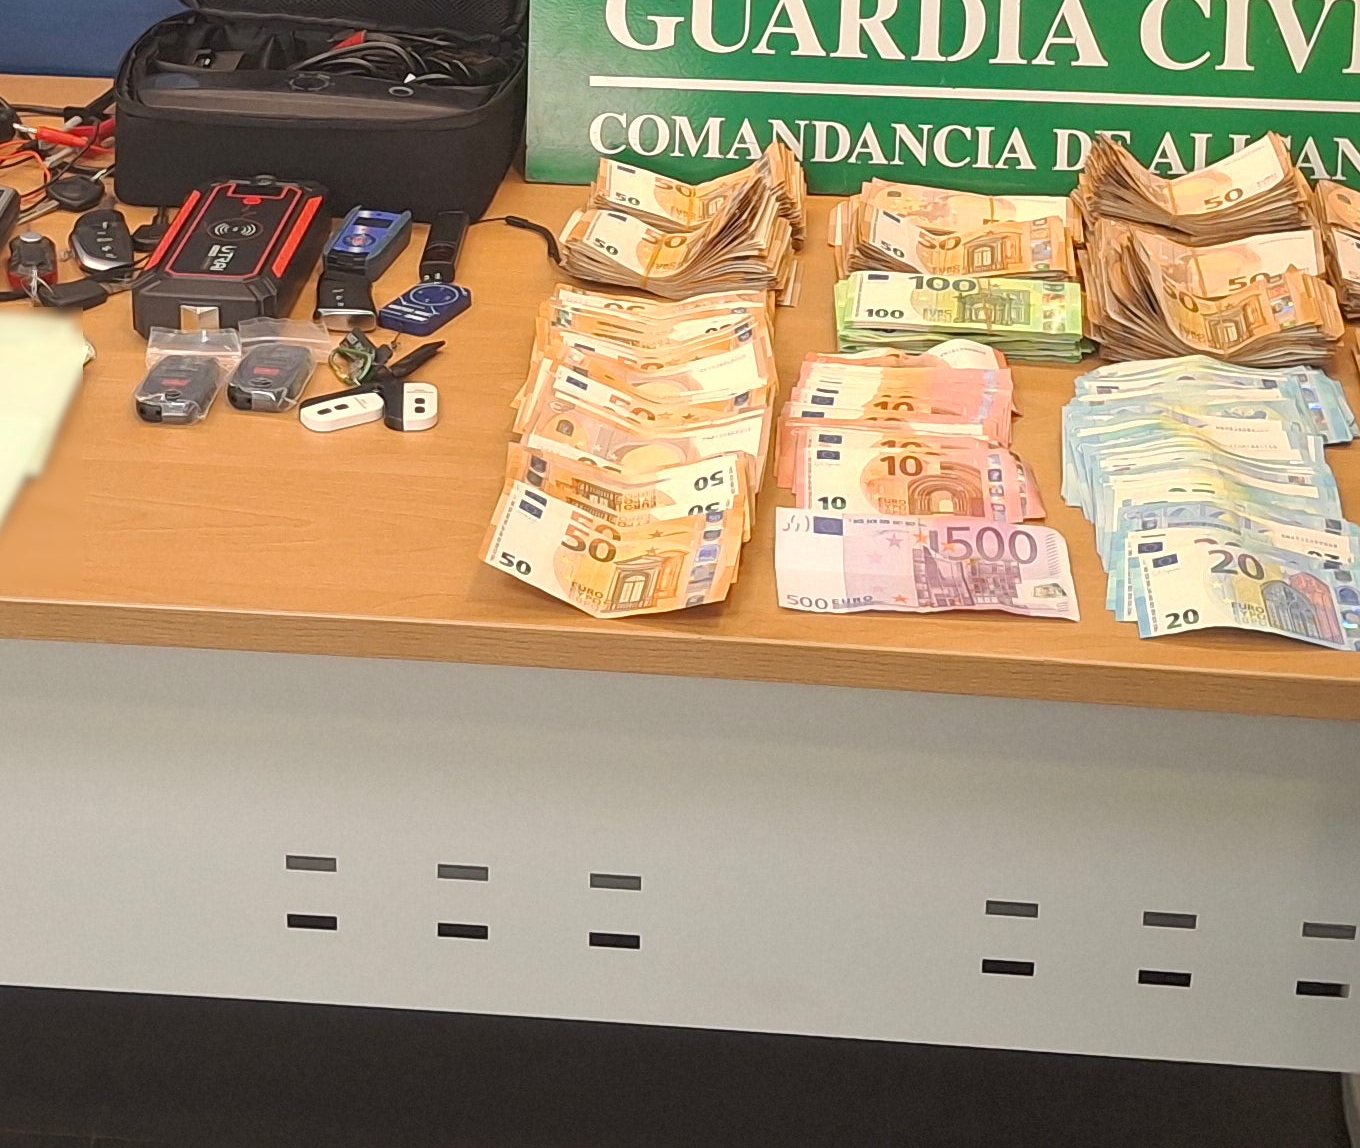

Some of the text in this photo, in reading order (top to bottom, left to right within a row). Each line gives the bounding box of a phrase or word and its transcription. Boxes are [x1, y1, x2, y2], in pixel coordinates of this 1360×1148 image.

[588, 112, 1035, 172] COMANDANCIA
[616, 192, 640, 206] 50
[1203, 188, 1244, 211] 50
[593, 238, 619, 256] 50
[880, 240, 905, 258] 50
[919, 233, 961, 250] 50
[909, 276, 977, 292] 100
[865, 309, 904, 319] 100
[880, 455, 923, 477] 10
[694, 470, 724, 491] 50
[817, 496, 847, 510] 10
[561, 524, 617, 563] 50
[946, 526, 1038, 565] 500
[499, 551, 532, 575] 50
[1208, 549, 1265, 580] 20
[787, 594, 828, 610] 500
[1165, 608, 1200, 630] 20
